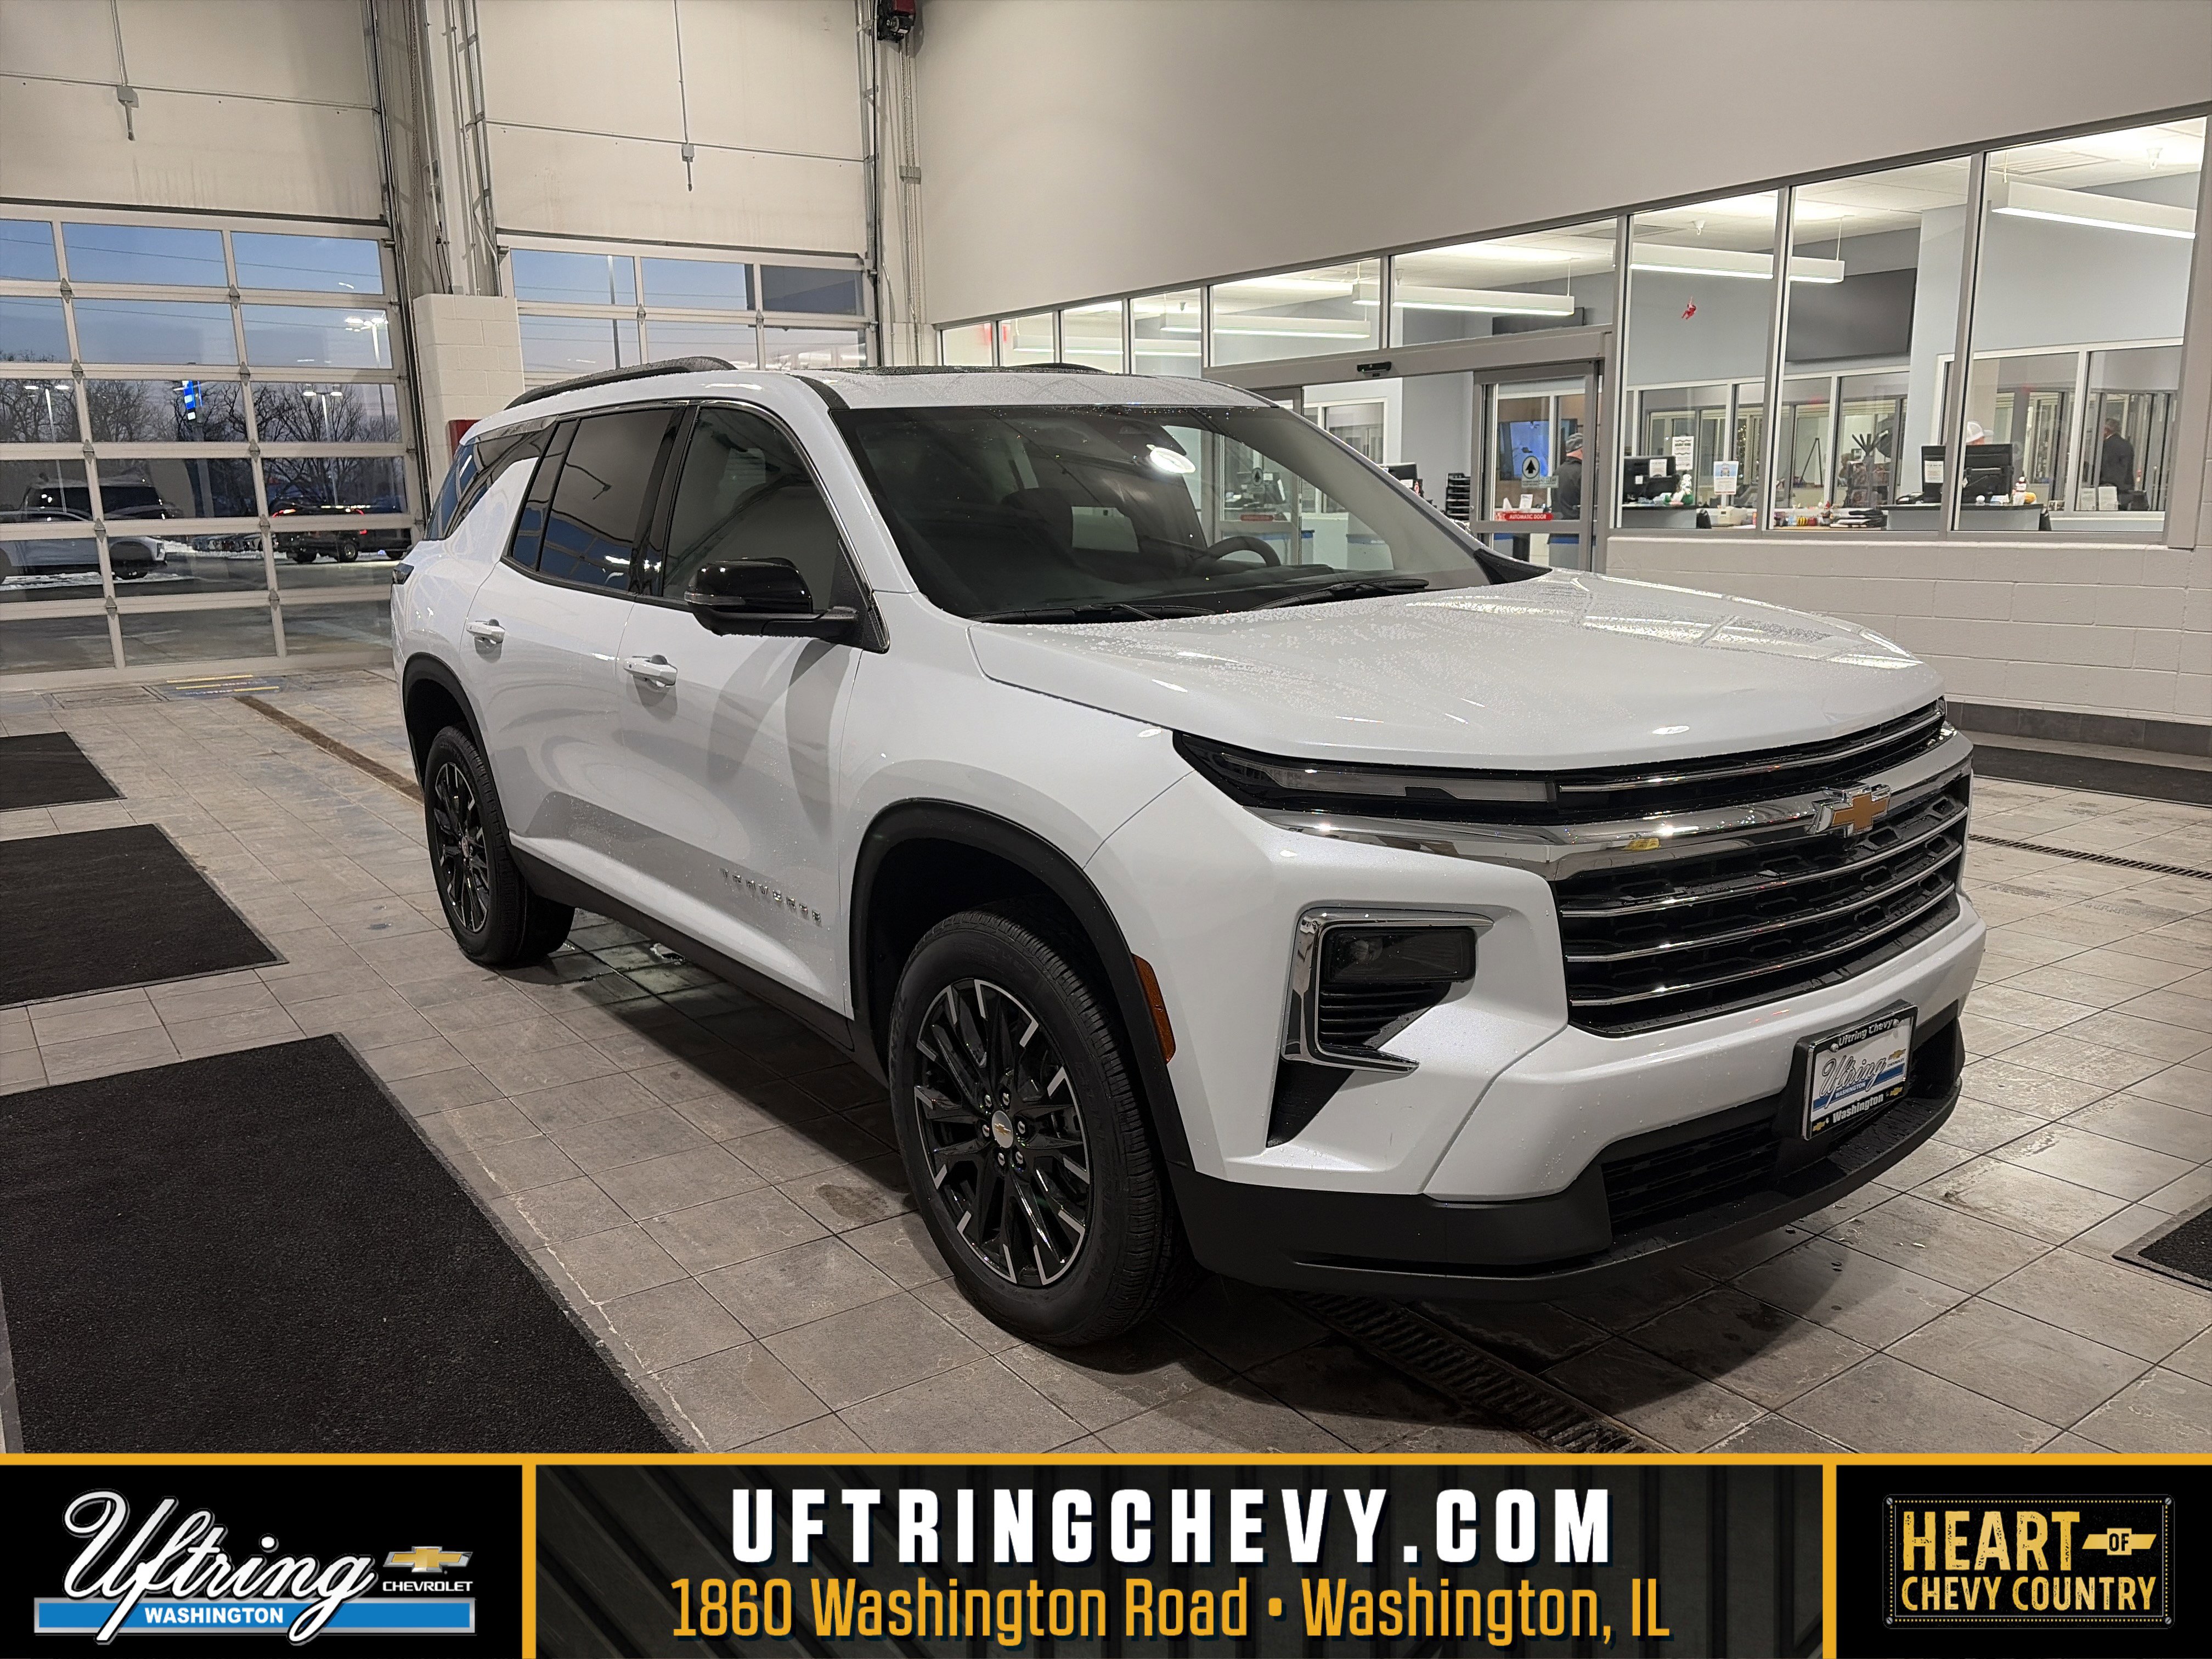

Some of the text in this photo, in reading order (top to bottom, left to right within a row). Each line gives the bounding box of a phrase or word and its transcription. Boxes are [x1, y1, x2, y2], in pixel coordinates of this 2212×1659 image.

[1838, 1019, 1893, 1046] Uftring Chevy
[1820, 1055, 1886, 1108] Uftring
[1835, 1081, 1865, 1098] WASHINGTON
[1833, 1093, 1884, 1123] Washington
